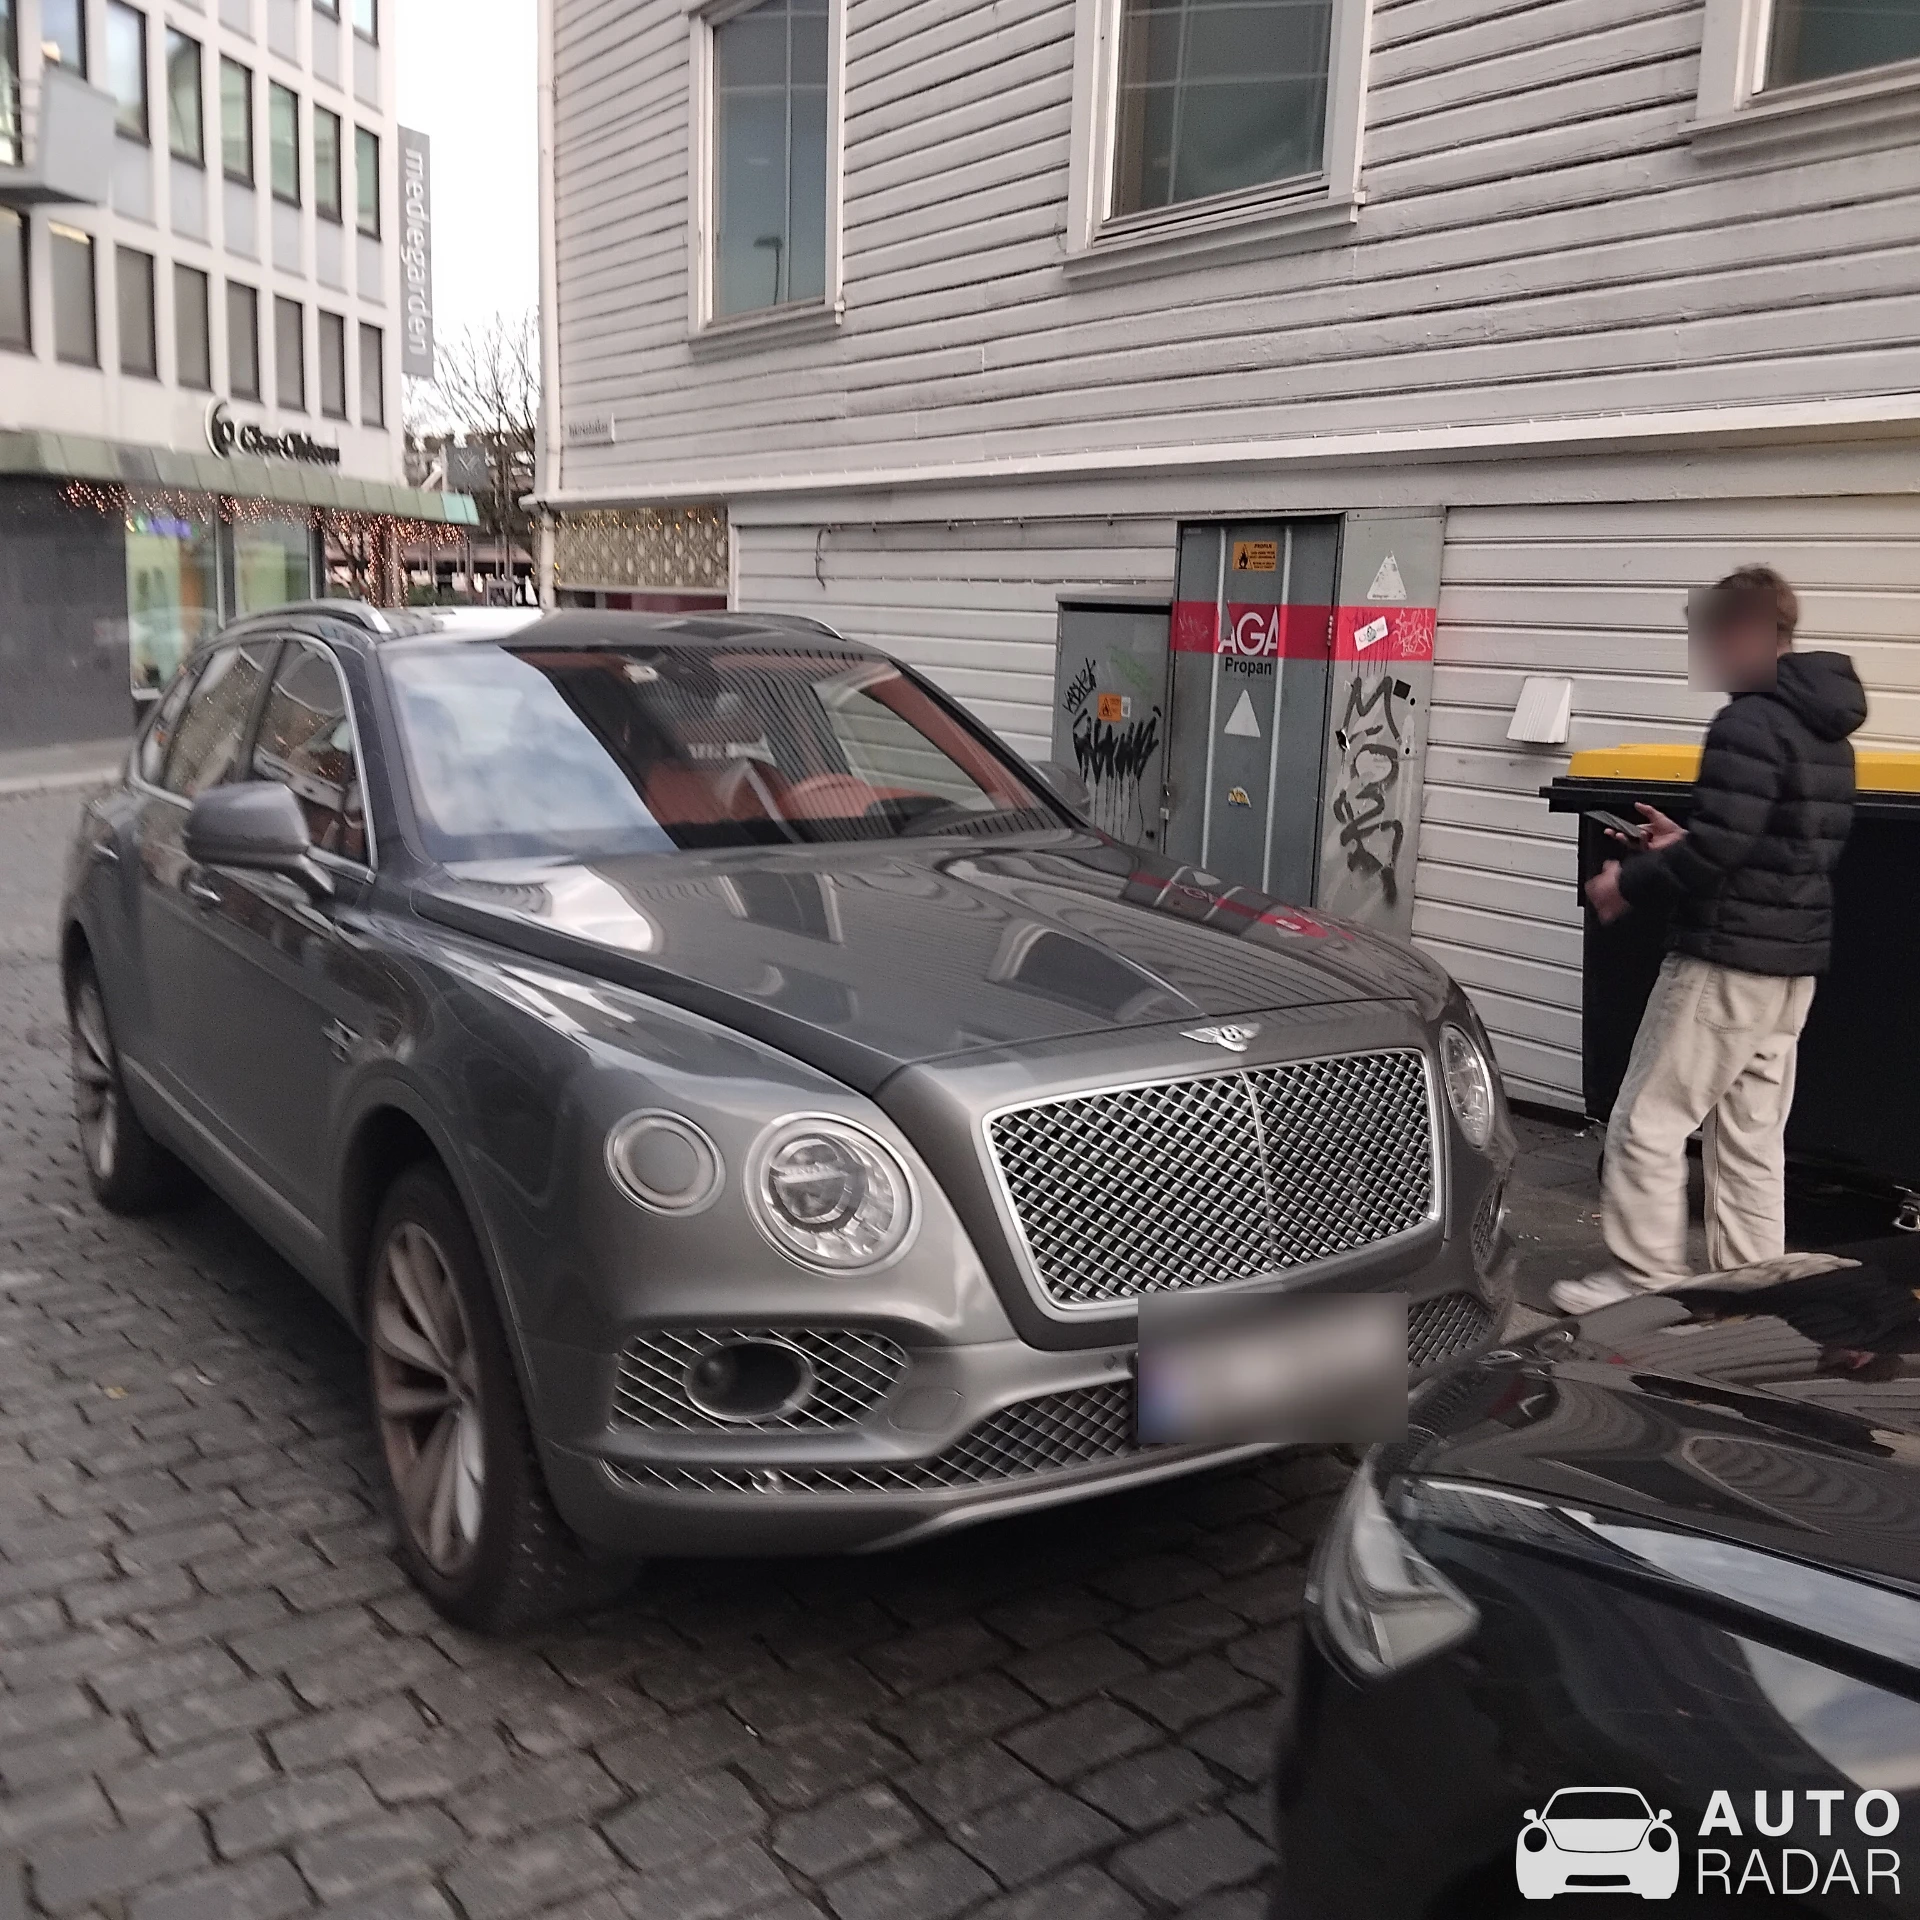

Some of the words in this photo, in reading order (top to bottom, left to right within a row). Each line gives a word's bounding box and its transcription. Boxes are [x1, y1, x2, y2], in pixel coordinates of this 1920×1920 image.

[401, 147, 433, 355] mediegarden
[1216, 604, 1279, 656] AGA
[1225, 657, 1272, 678] Propan
